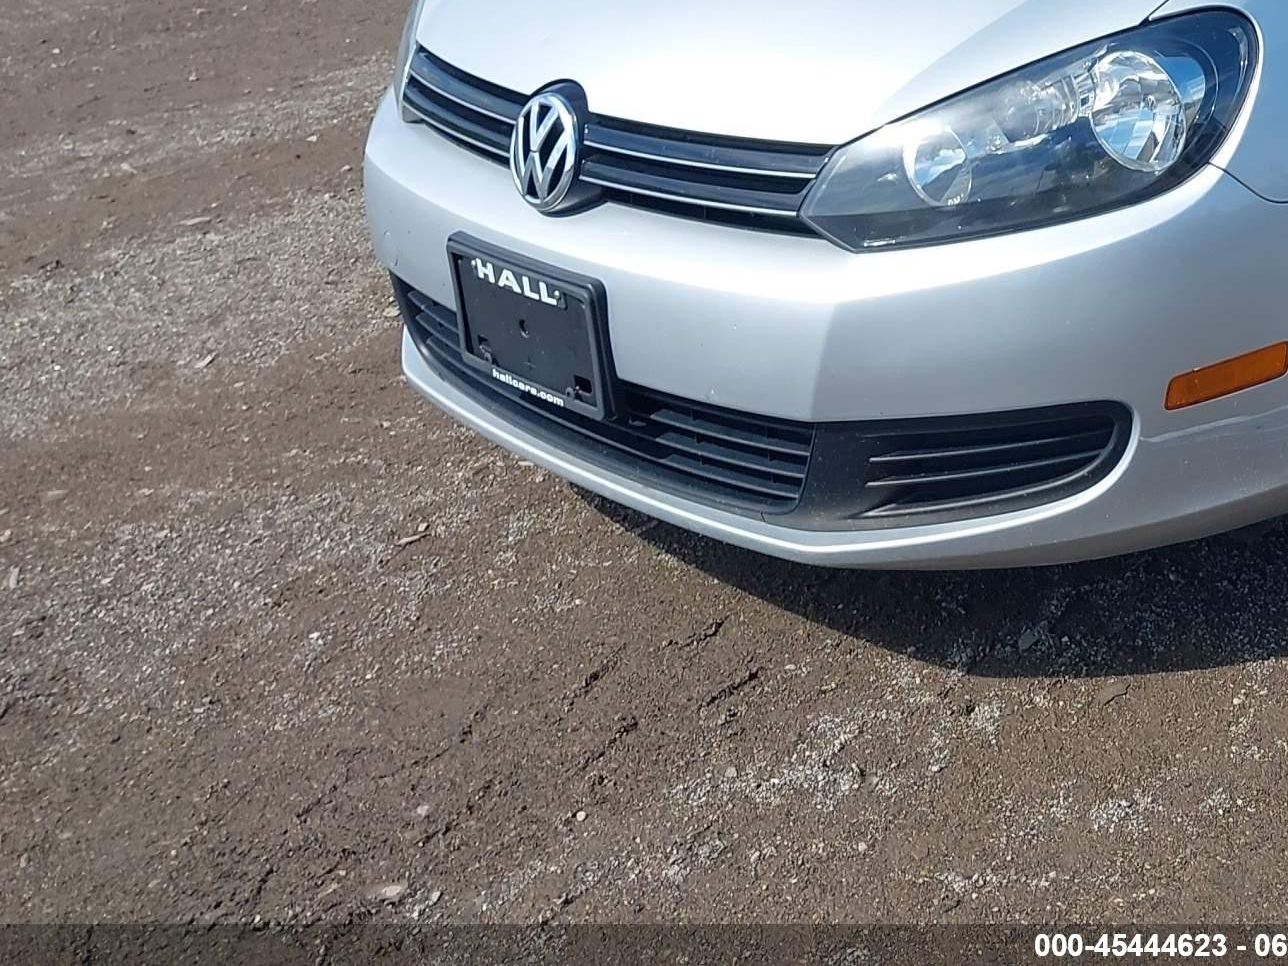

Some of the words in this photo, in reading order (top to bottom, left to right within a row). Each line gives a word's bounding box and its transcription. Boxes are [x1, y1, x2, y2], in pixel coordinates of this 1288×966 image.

[509, 92, 577, 211] VW
[475, 257, 559, 307] HALL
[492, 367, 565, 408] hallcars.com
